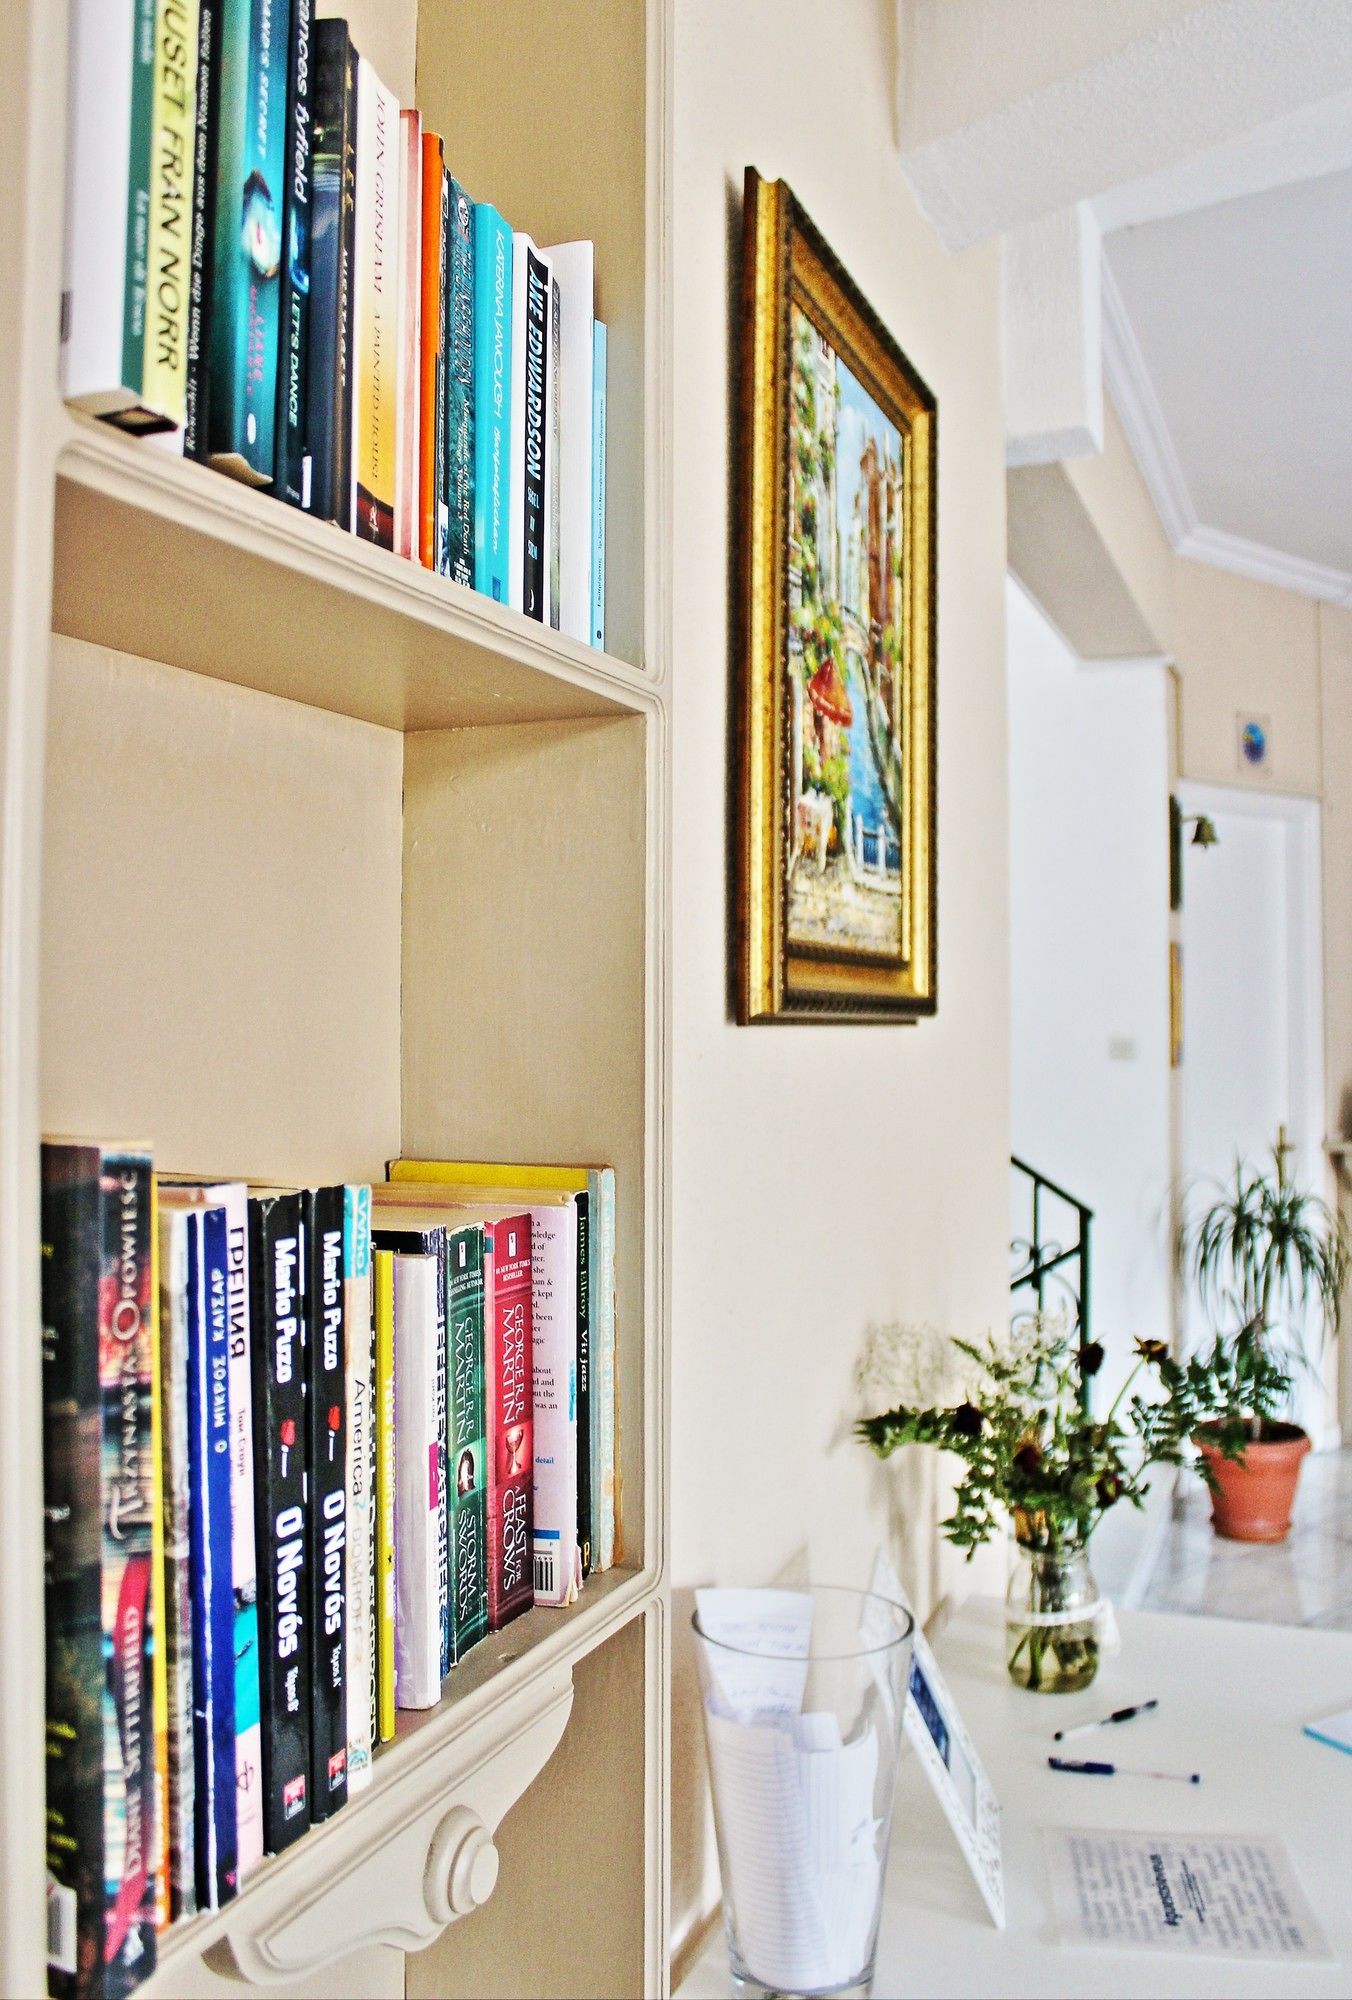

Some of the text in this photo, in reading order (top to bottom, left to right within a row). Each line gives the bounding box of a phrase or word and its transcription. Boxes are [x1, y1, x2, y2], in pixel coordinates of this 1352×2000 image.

[295, 102, 310, 204] fyfield
[374, 94, 386, 294] JOHN GRISHAM
[158, 249, 182, 369] NORR
[494, 230, 505, 420] KATERINA JANOUCH
[528, 268, 548, 321] ÅKE
[288, 292, 301, 428] LET'S DANCE
[527, 319, 544, 481] EDWARDSON
[462, 398, 470, 461] Masquerade
[356, 1201, 367, 1270] Who
[579, 1215, 587, 1318] James Ellroy
[211, 1268, 226, 1342] ΚΑΙΣΑΡ
[275, 1236, 297, 1383] Mario Puzo
[323, 1230, 341, 1371] Mario Puzo
[536, 1313, 553, 1321] been
[537, 1290, 553, 1299] kept
[455, 1322, 466, 1445] MARTIN
[465, 1317, 474, 1397] GEORGE
[503, 1308, 515, 1425] MARTIN
[515, 1304, 524, 1380] GEORGE
[580, 1358, 588, 1393] jazz
[213, 1355, 227, 1429] ΜΙΚΡΟΣ
[543, 1390, 555, 1398] the
[535, 1456, 555, 1464] detail
[458, 1510, 467, 1621] SWORDS
[467, 1515, 477, 1597] STORM
[503, 1489, 515, 1590] CROWS
[515, 1494, 527, 1556] FEAST
[352, 1528, 363, 1635] DOMHOFF
